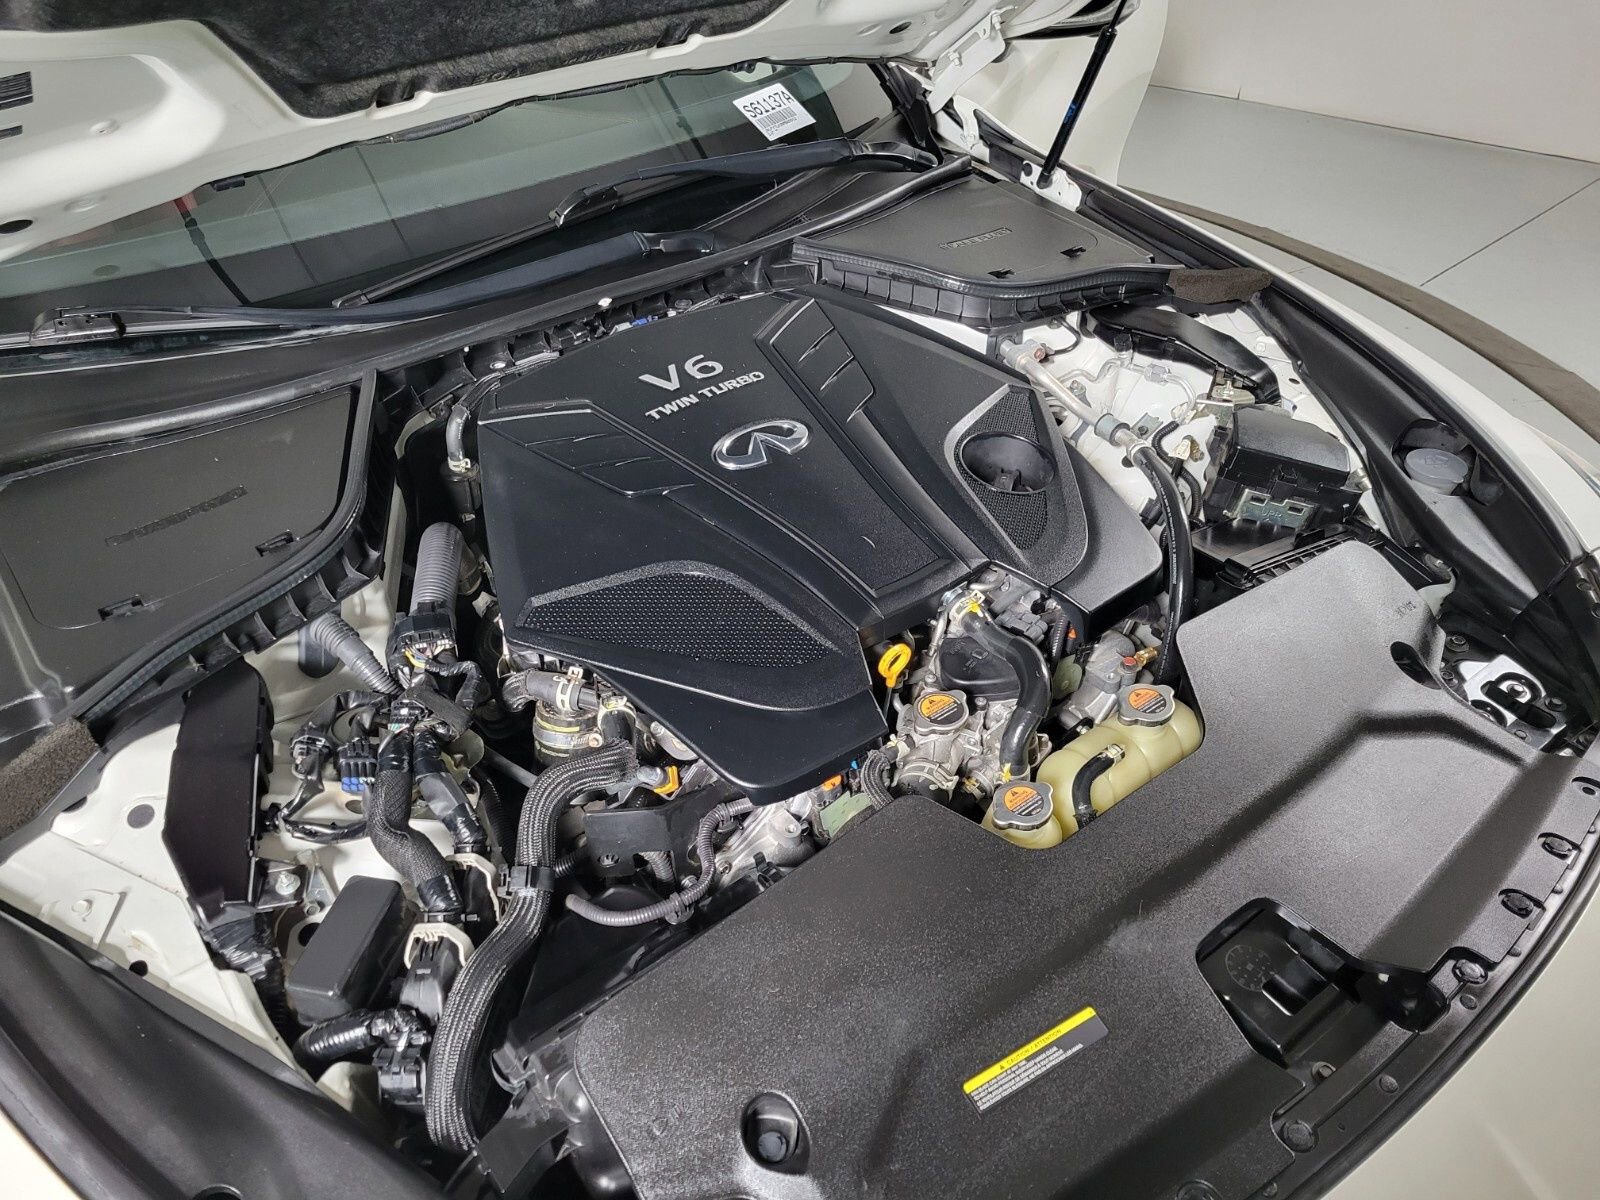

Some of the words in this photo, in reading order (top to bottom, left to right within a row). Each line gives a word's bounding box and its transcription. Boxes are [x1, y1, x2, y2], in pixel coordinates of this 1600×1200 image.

[742, 90, 795, 118] S61137A
[638, 354, 724, 391] V6
[645, 393, 700, 420] TWIN
[698, 371, 765, 398] TURBO
[1006, 1047, 1030, 1066] CAUTION
